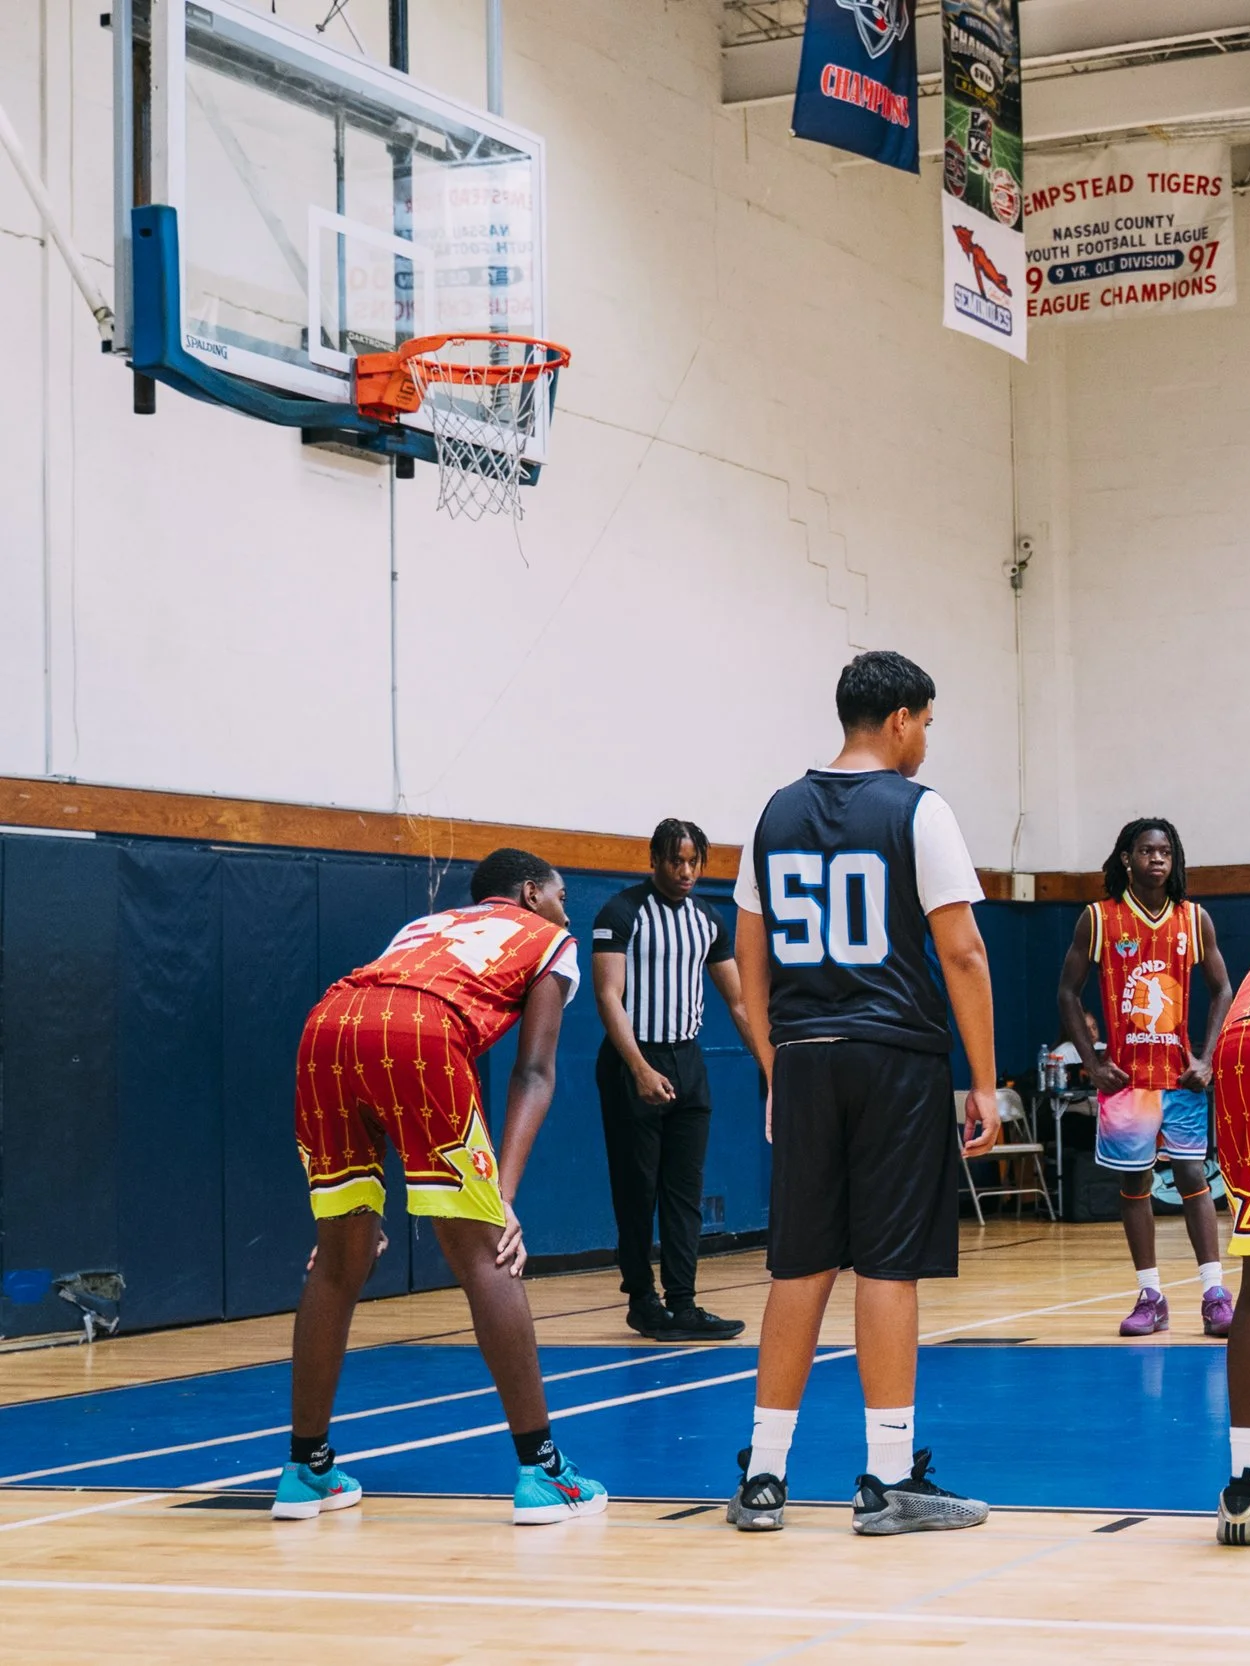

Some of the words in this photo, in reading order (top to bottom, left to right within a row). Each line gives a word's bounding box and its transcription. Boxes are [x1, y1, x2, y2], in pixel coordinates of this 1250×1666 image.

[820, 63, 910, 129] CHAMPIONS
[1147, 173, 1223, 197] TIGERS
[1053, 221, 1110, 241] NASSAU
[1115, 214, 1175, 233] COUNTY
[1025, 244, 1070, 263] YOUTH
[1077, 233, 1147, 256] FOOTBALL
[1155, 226, 1209, 245] LEAGUE
[1055, 268, 1064, 281] 9
[1070, 263, 1091, 277] YR.
[1095, 260, 1115, 275] OLD
[1120, 253, 1176, 270] DIVISION
[1188, 240, 1220, 272] 97
[1101, 275, 1218, 306] CHAMPIONS
[186, 334, 229, 360] SPALDING
[767, 850, 892, 967] 50
[1176, 932, 1188, 956] 3
